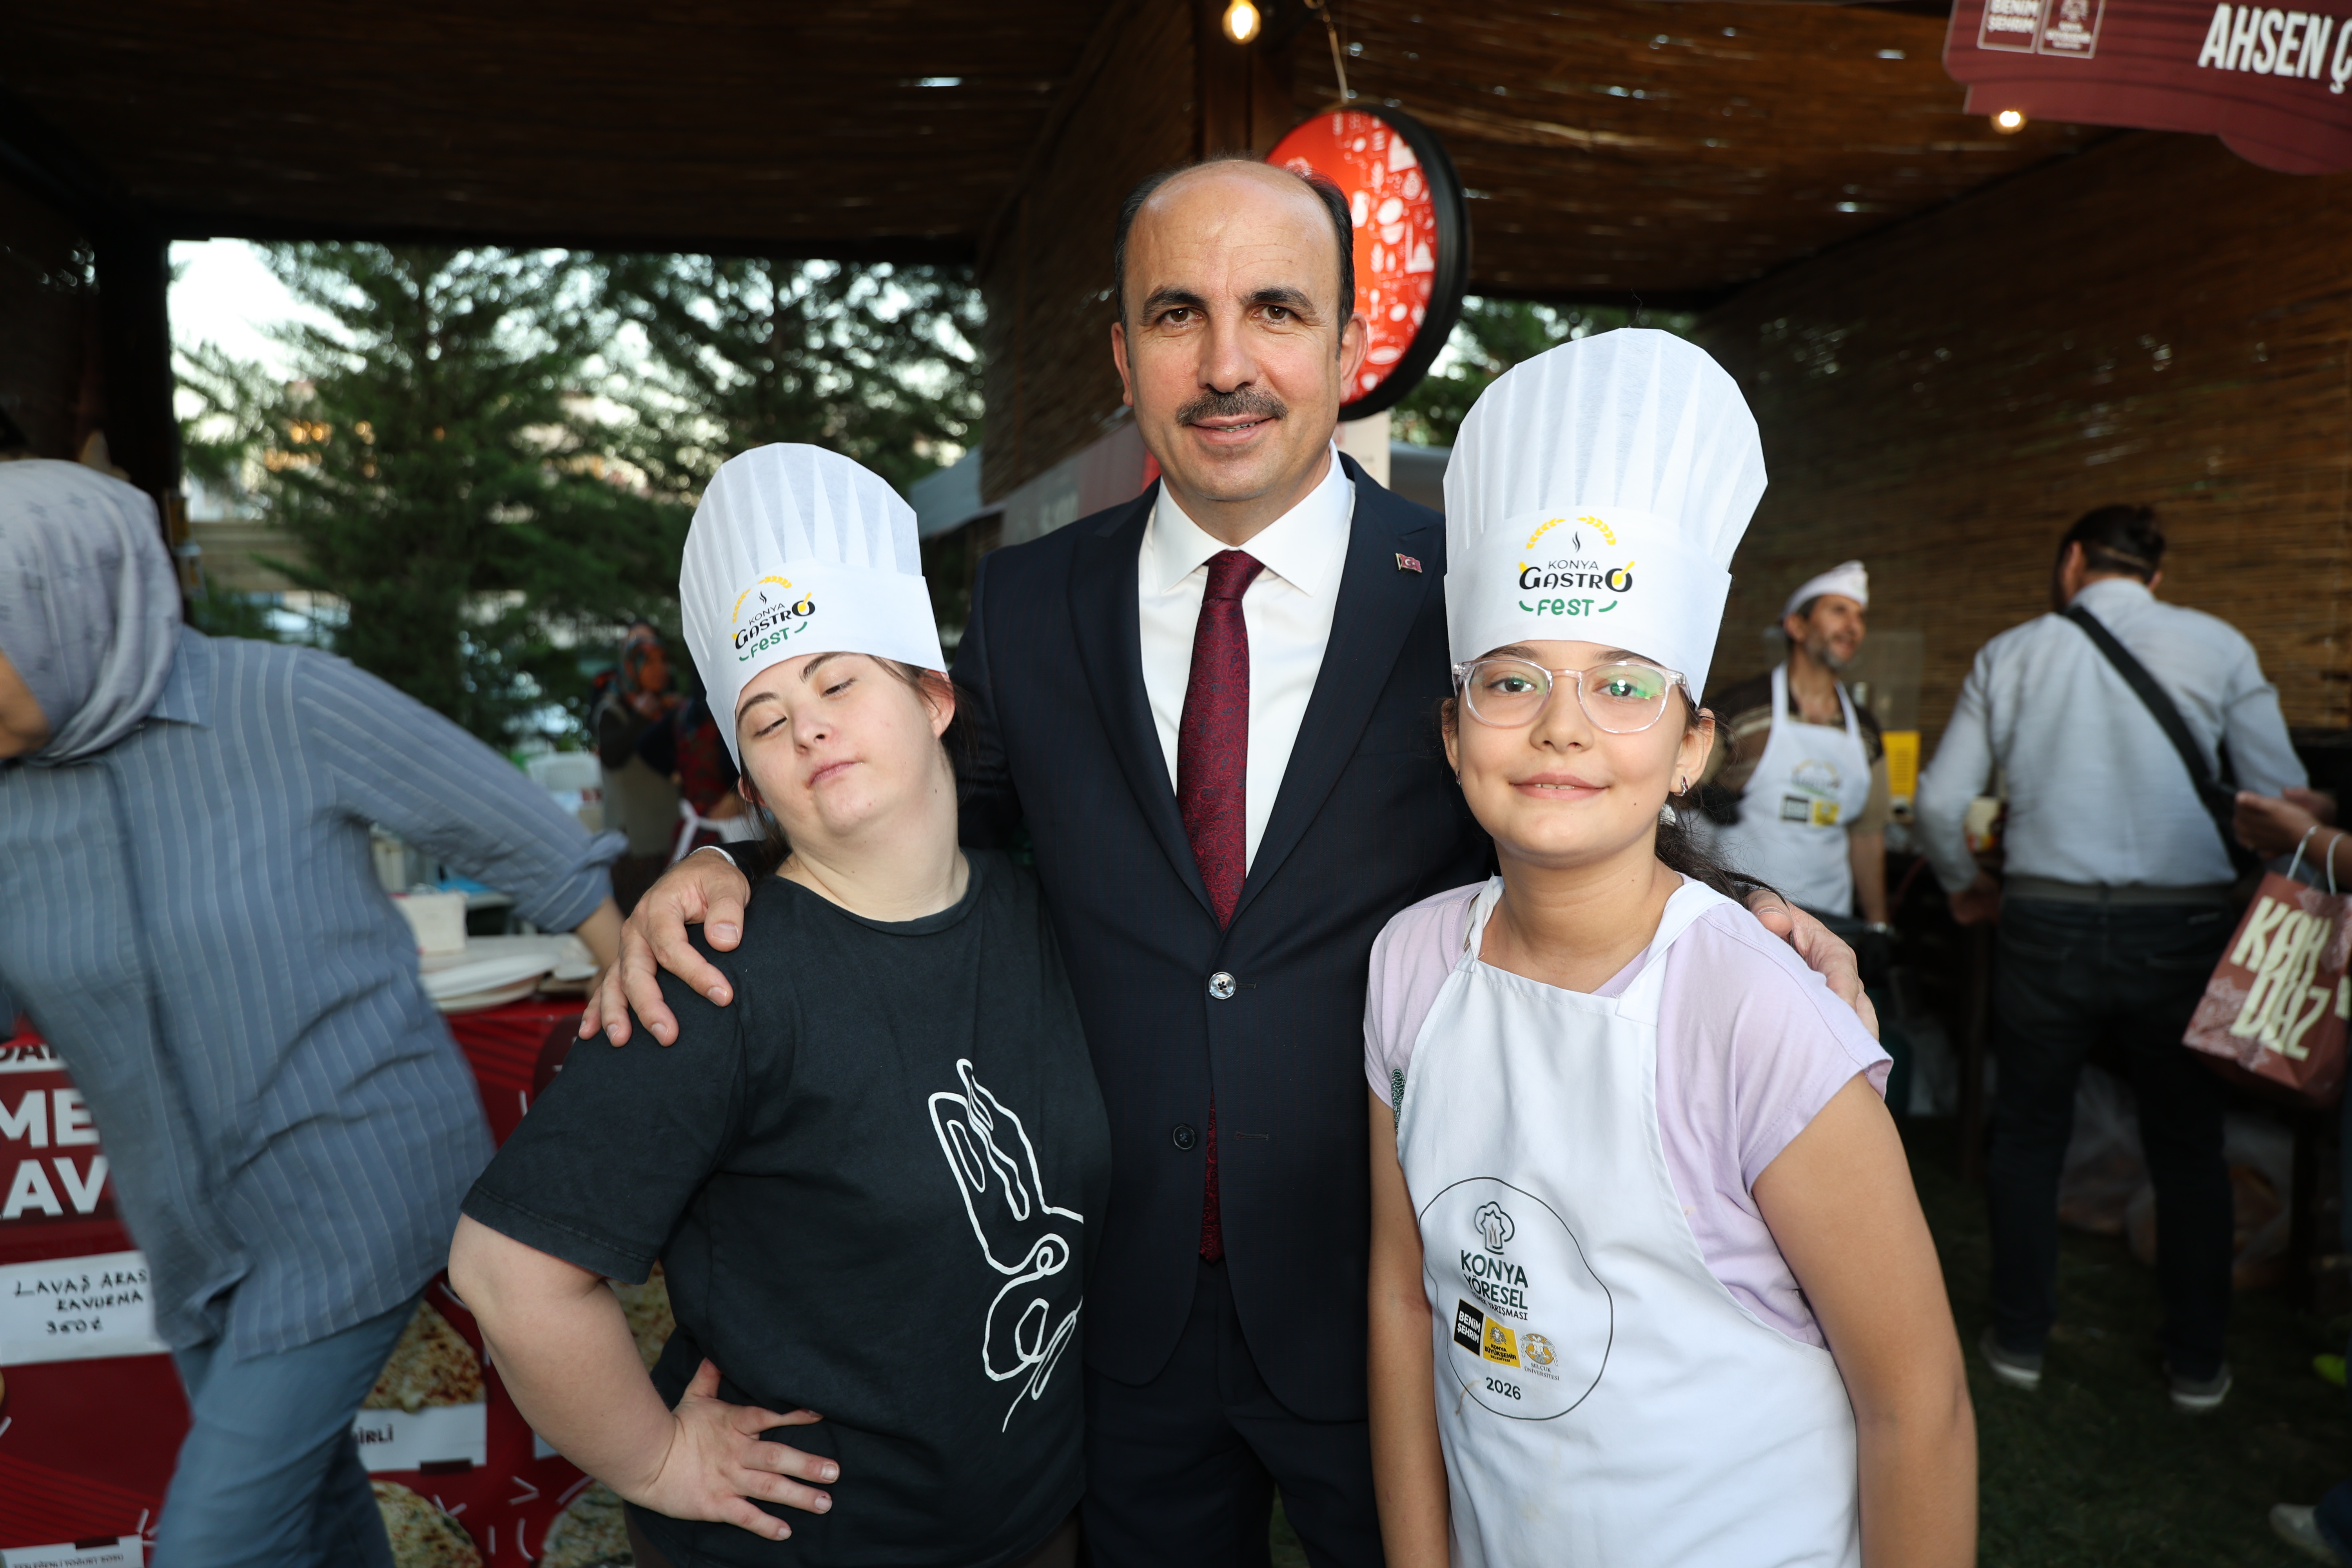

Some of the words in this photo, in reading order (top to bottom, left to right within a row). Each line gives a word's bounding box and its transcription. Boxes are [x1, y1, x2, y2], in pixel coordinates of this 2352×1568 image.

[2198, 2, 2334, 79] AHSEN
[1548, 560, 1599, 570] KONYA
[749, 603, 785, 625] KONYA
[1461, 1249, 1528, 1288] KONYA
[1463, 1274, 1528, 1310] YÖRESEL
[1488, 1302, 1528, 1320] YARIŞMASI
[1485, 1346, 1517, 1360] BÜYÜKŞEHİR
[1491, 1343, 1507, 1352] KONYA
[1524, 1367, 1559, 1381] ÜNİVERSİTESİ
[1531, 1363, 1551, 1373] SELÇUK
[1486, 1377, 1521, 1400] 2026
[354, 1423, 394, 1444] İRLİ
